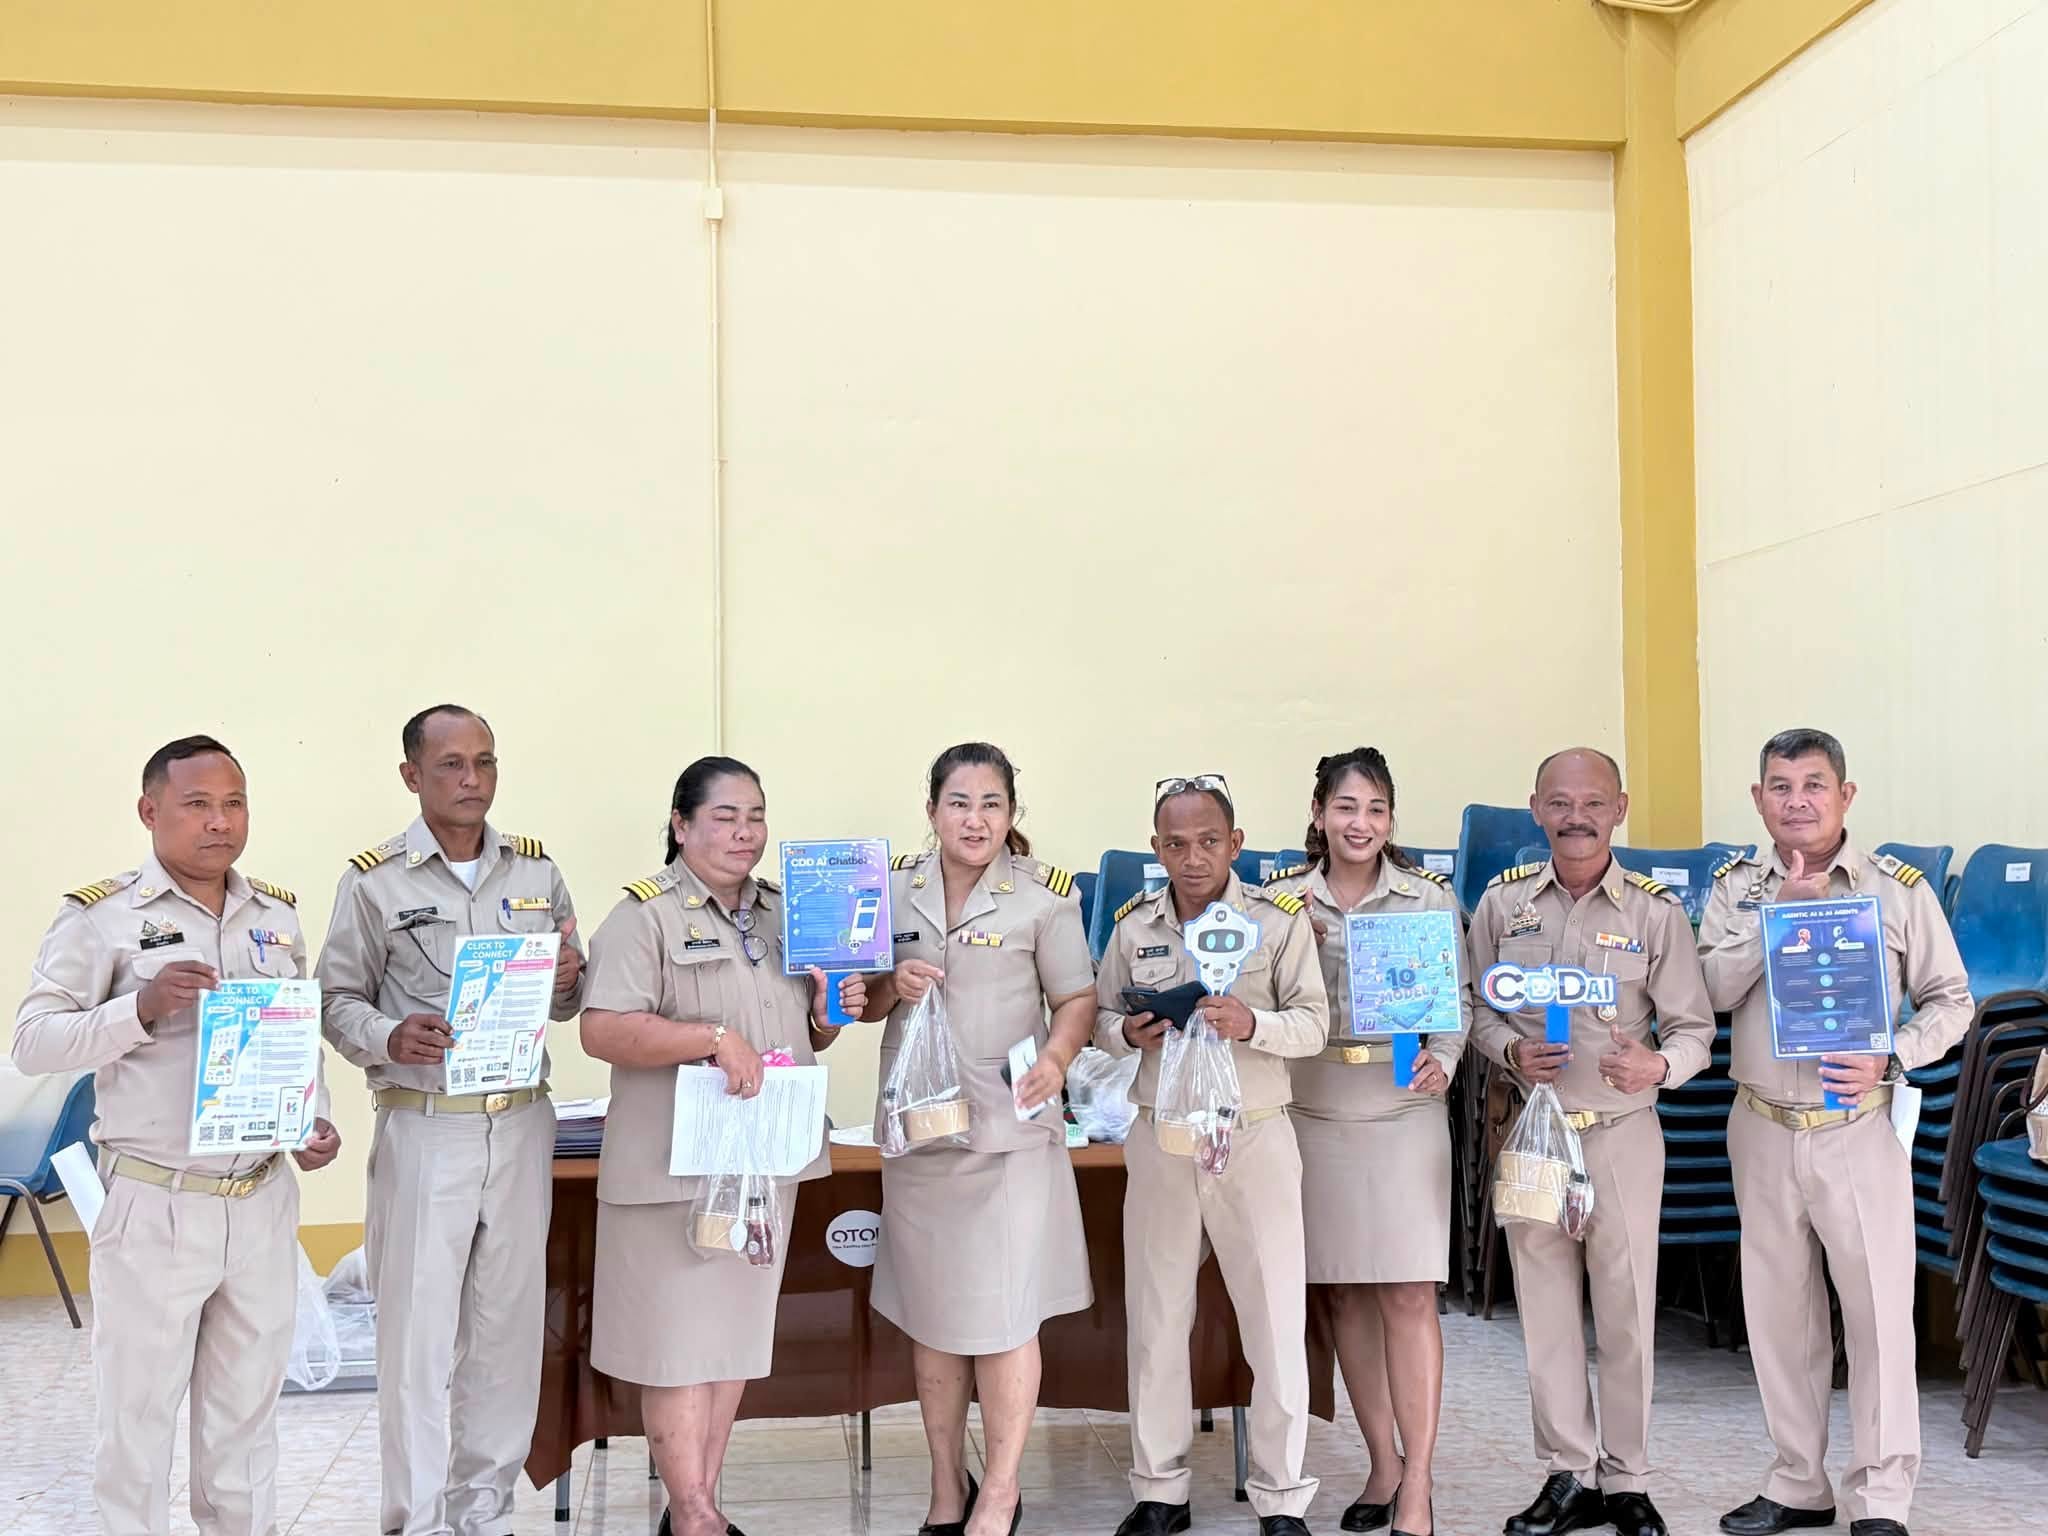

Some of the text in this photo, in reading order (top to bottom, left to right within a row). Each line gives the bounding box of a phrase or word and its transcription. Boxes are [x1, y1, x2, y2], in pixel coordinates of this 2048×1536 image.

[467, 941, 505, 950] CLICK TO
[472, 950, 513, 959] CONNECT
[1386, 967, 1416, 989] 10
[221, 984, 258, 994] LICK TO
[223, 996, 269, 1005] CONNECT
